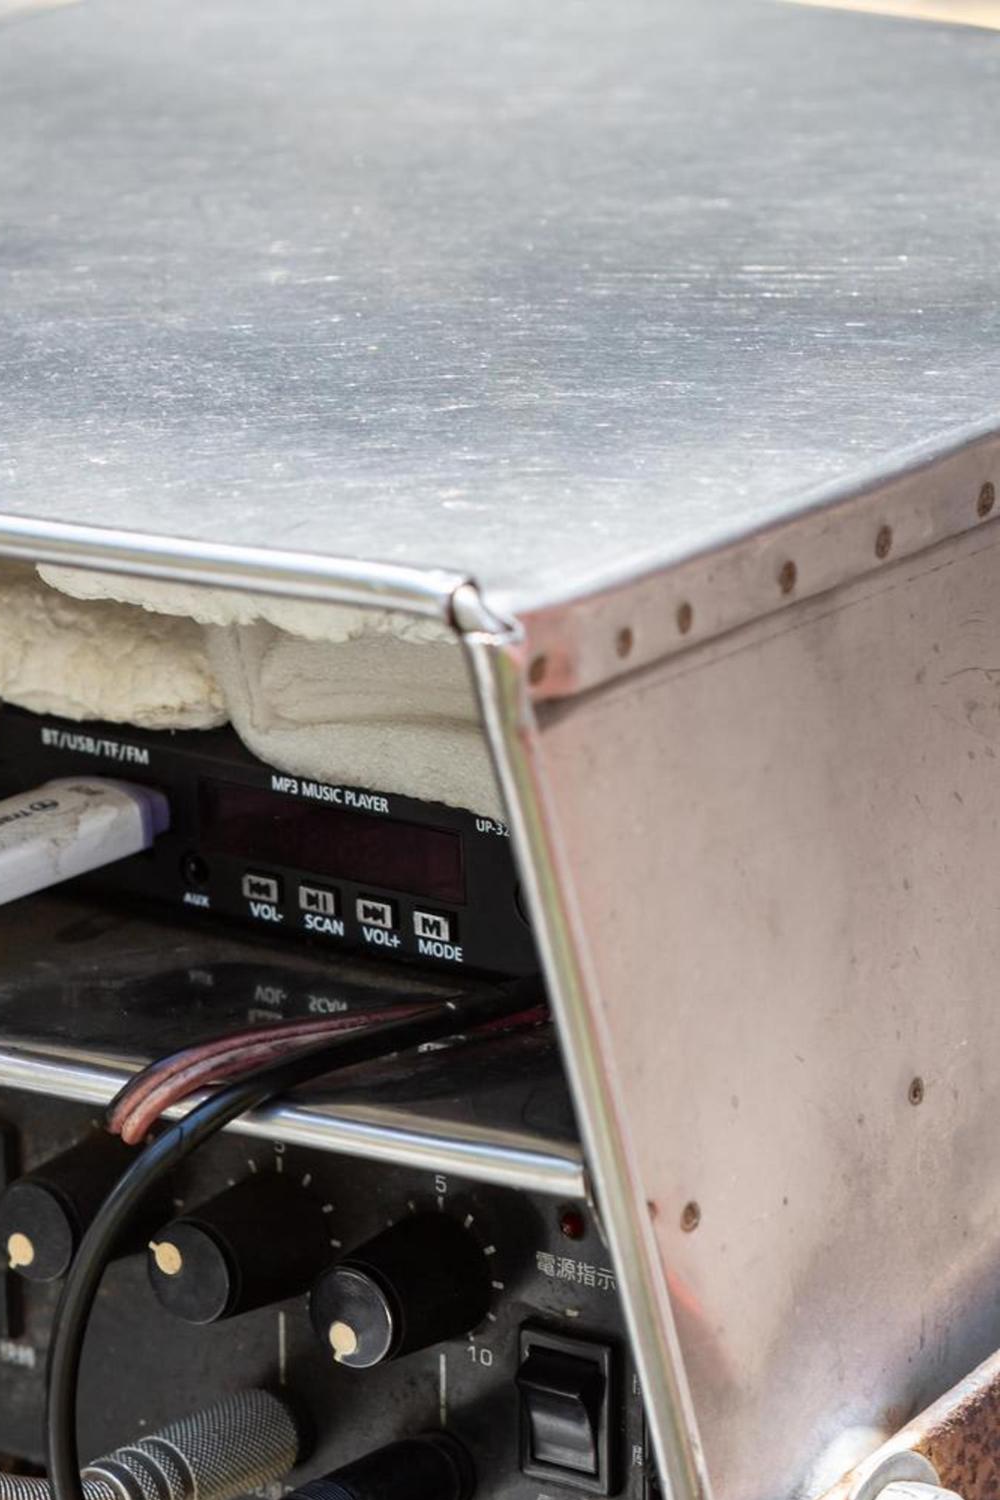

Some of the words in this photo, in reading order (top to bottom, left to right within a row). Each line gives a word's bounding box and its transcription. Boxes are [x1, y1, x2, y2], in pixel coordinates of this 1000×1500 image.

[41, 728, 149, 765] BT/USB/TF/FM
[271, 775, 299, 795] MP3
[301, 781, 342, 804] MUSIC
[344, 790, 390, 814] PLAYER
[184, 892, 210, 907] AUX
[249, 901, 284, 922] VOL-
[305, 913, 344, 936] SCAN
[362, 926, 401, 948] VOL+
[418, 938, 464, 963] MODE
[435, 1174, 448, 1194] 5
[535, 1250, 617, 1291] 電源指示
[467, 1345, 494, 1367] 10
